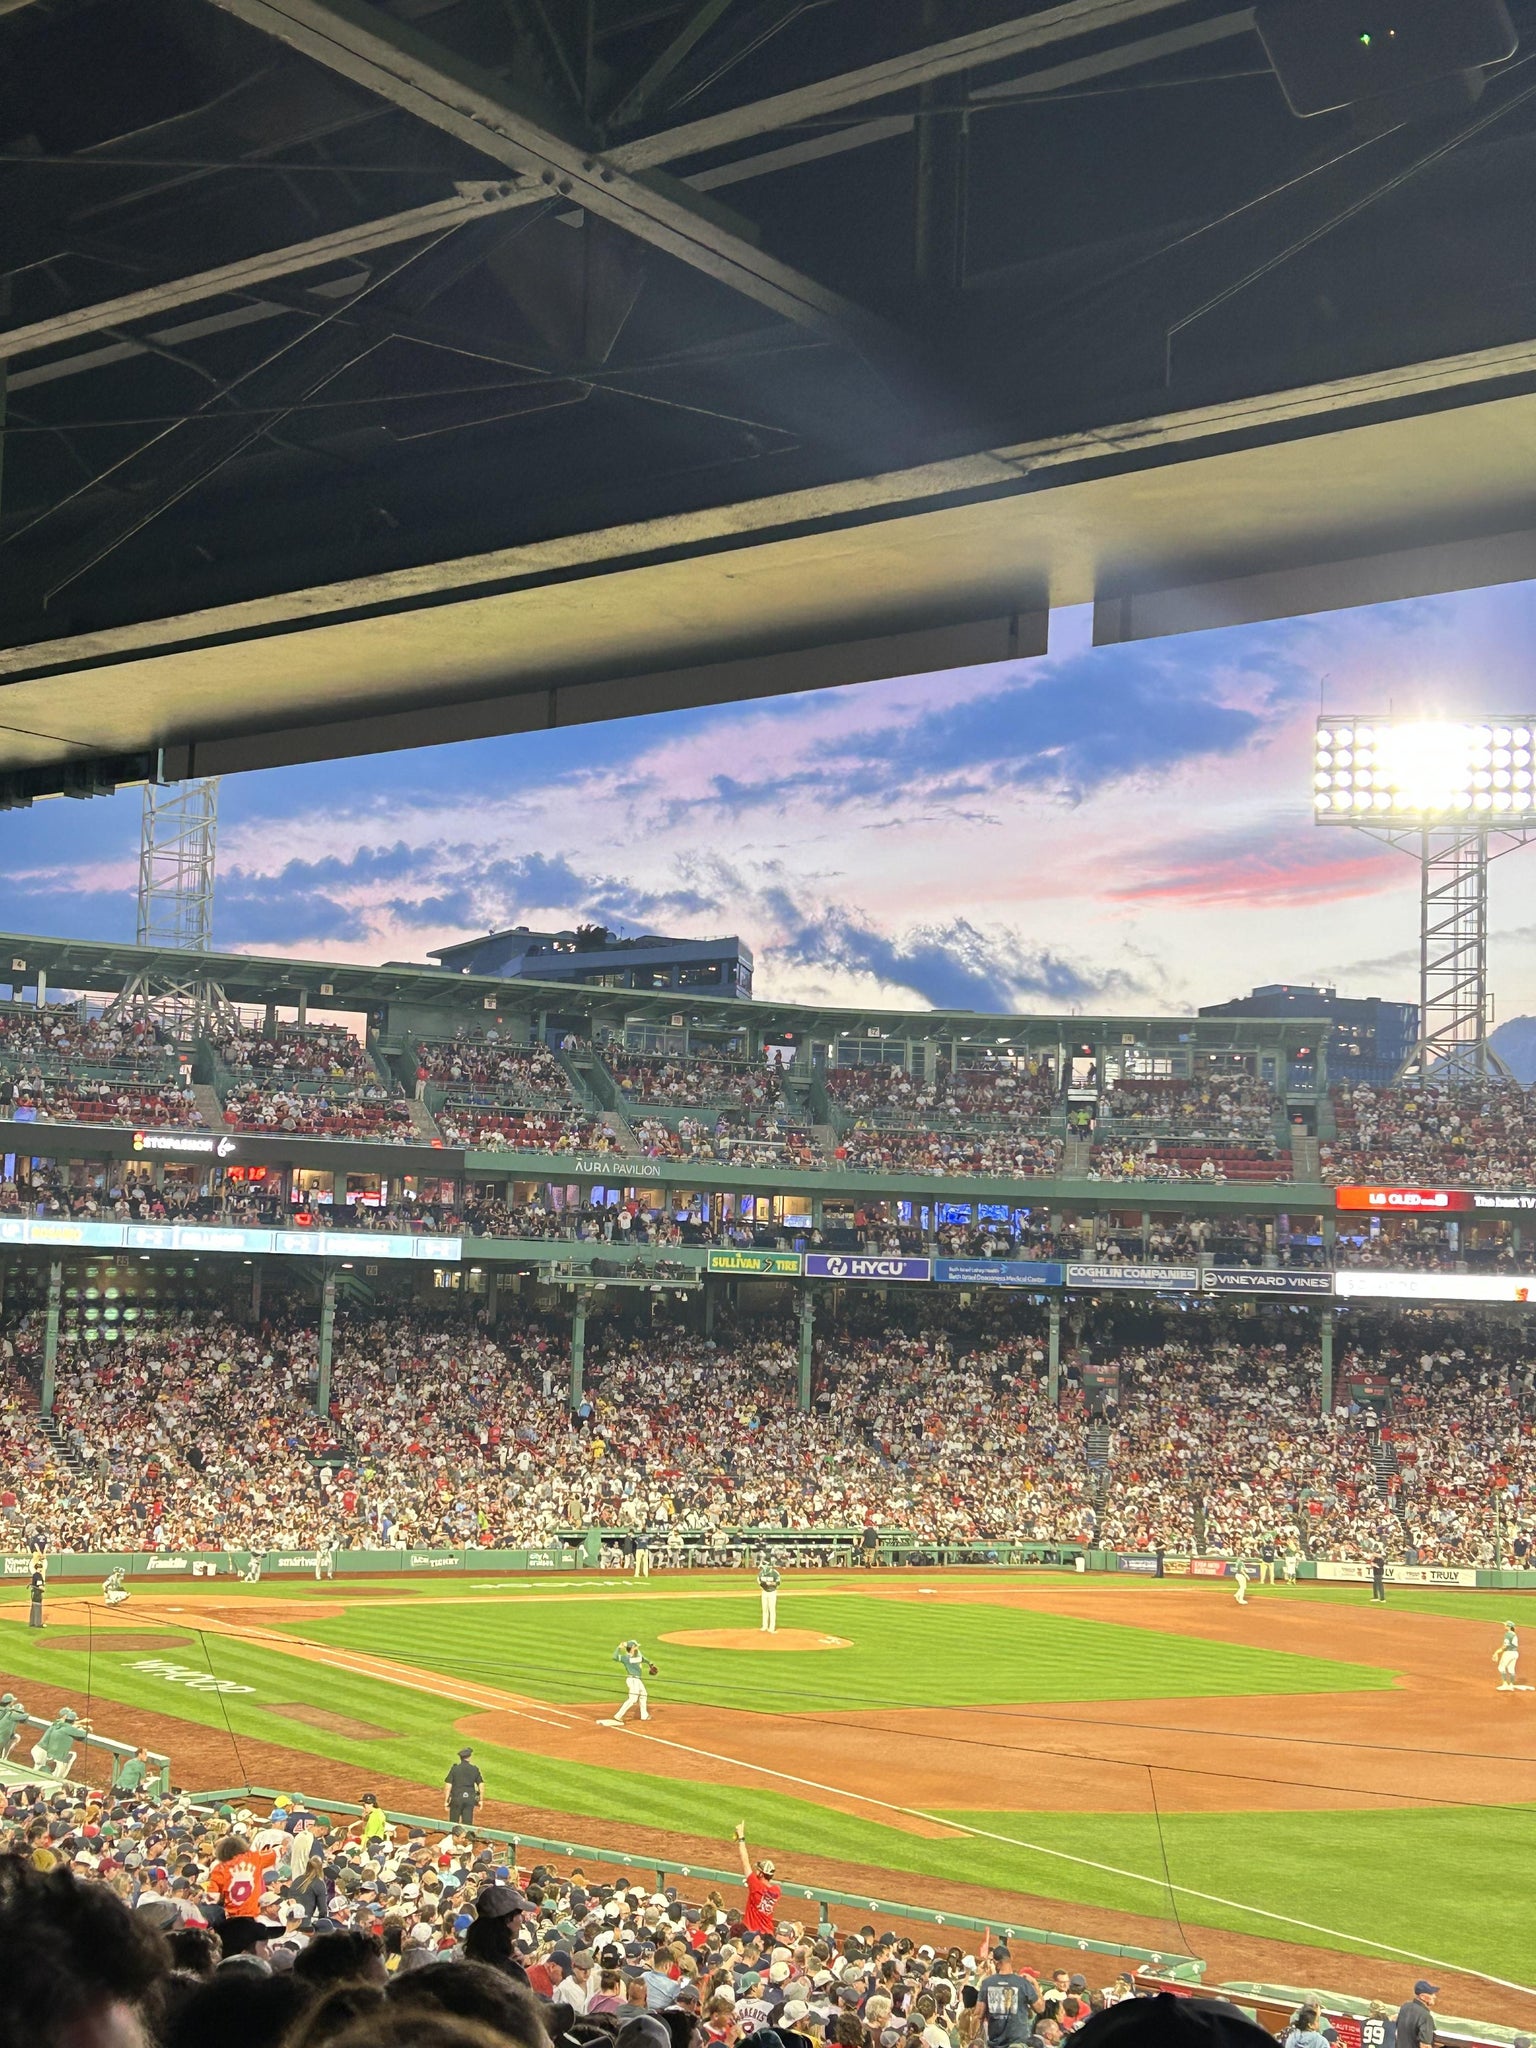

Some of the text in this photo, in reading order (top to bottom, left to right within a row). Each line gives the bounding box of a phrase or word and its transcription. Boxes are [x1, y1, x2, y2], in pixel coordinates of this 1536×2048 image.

[613, 1163, 661, 1176] PAVILION
[712, 1255, 798, 1272] SULLIVAN TIRE
[851, 1261, 904, 1275] HYCU
[1069, 1267, 1196, 1280] COGHLIN COMPANIES
[1217, 1275, 1329, 1288] VINEYARD VINES
[4, 1564, 29, 1574] Nine
[1430, 1571, 1459, 1580] TRULY
[1362, 2026, 1385, 2045] 99
